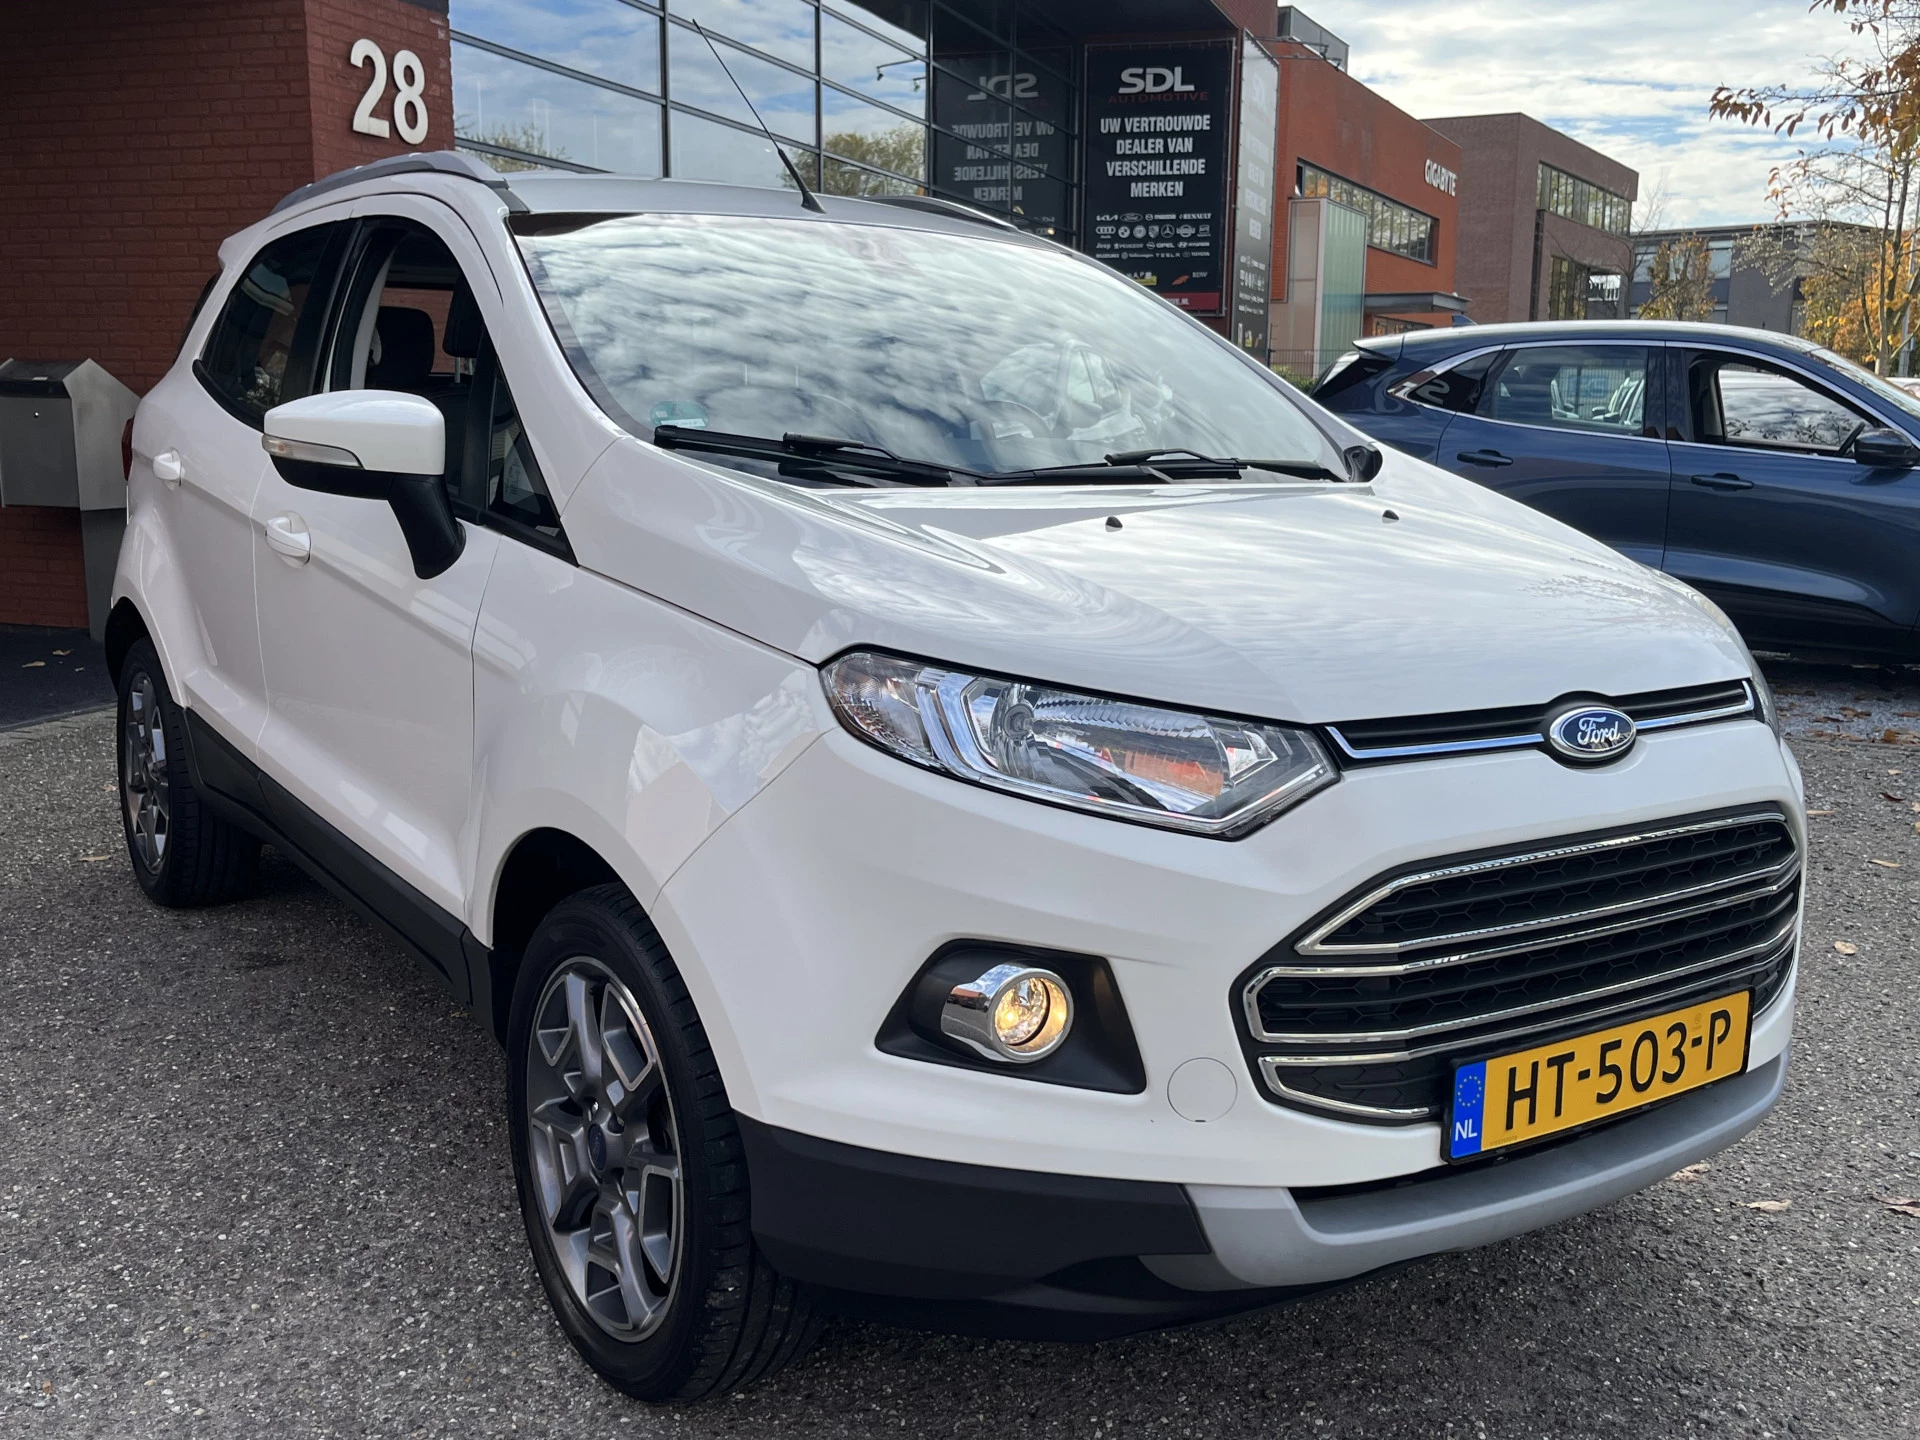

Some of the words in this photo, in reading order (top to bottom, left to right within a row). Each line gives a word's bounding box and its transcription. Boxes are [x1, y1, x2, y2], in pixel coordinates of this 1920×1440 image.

[1118, 66, 1195, 94] SDL
[350, 38, 428, 145] 28
[1108, 91, 1208, 104] AUTOMOTIVE
[1100, 118, 1121, 133] UW
[1124, 114, 1211, 133] VERTROUWDE
[1116, 138, 1164, 155] DEALER
[1167, 137, 1193, 153] VAN
[1106, 159, 1206, 176] VERSCHILLENDE
[1130, 181, 1184, 198] MERKEN
[1182, 212, 1212, 220] RENAULT
[1577, 716, 1620, 745] Ford
[1505, 1009, 1731, 1131] HT-503-P
[1454, 1118, 1478, 1142] NL
